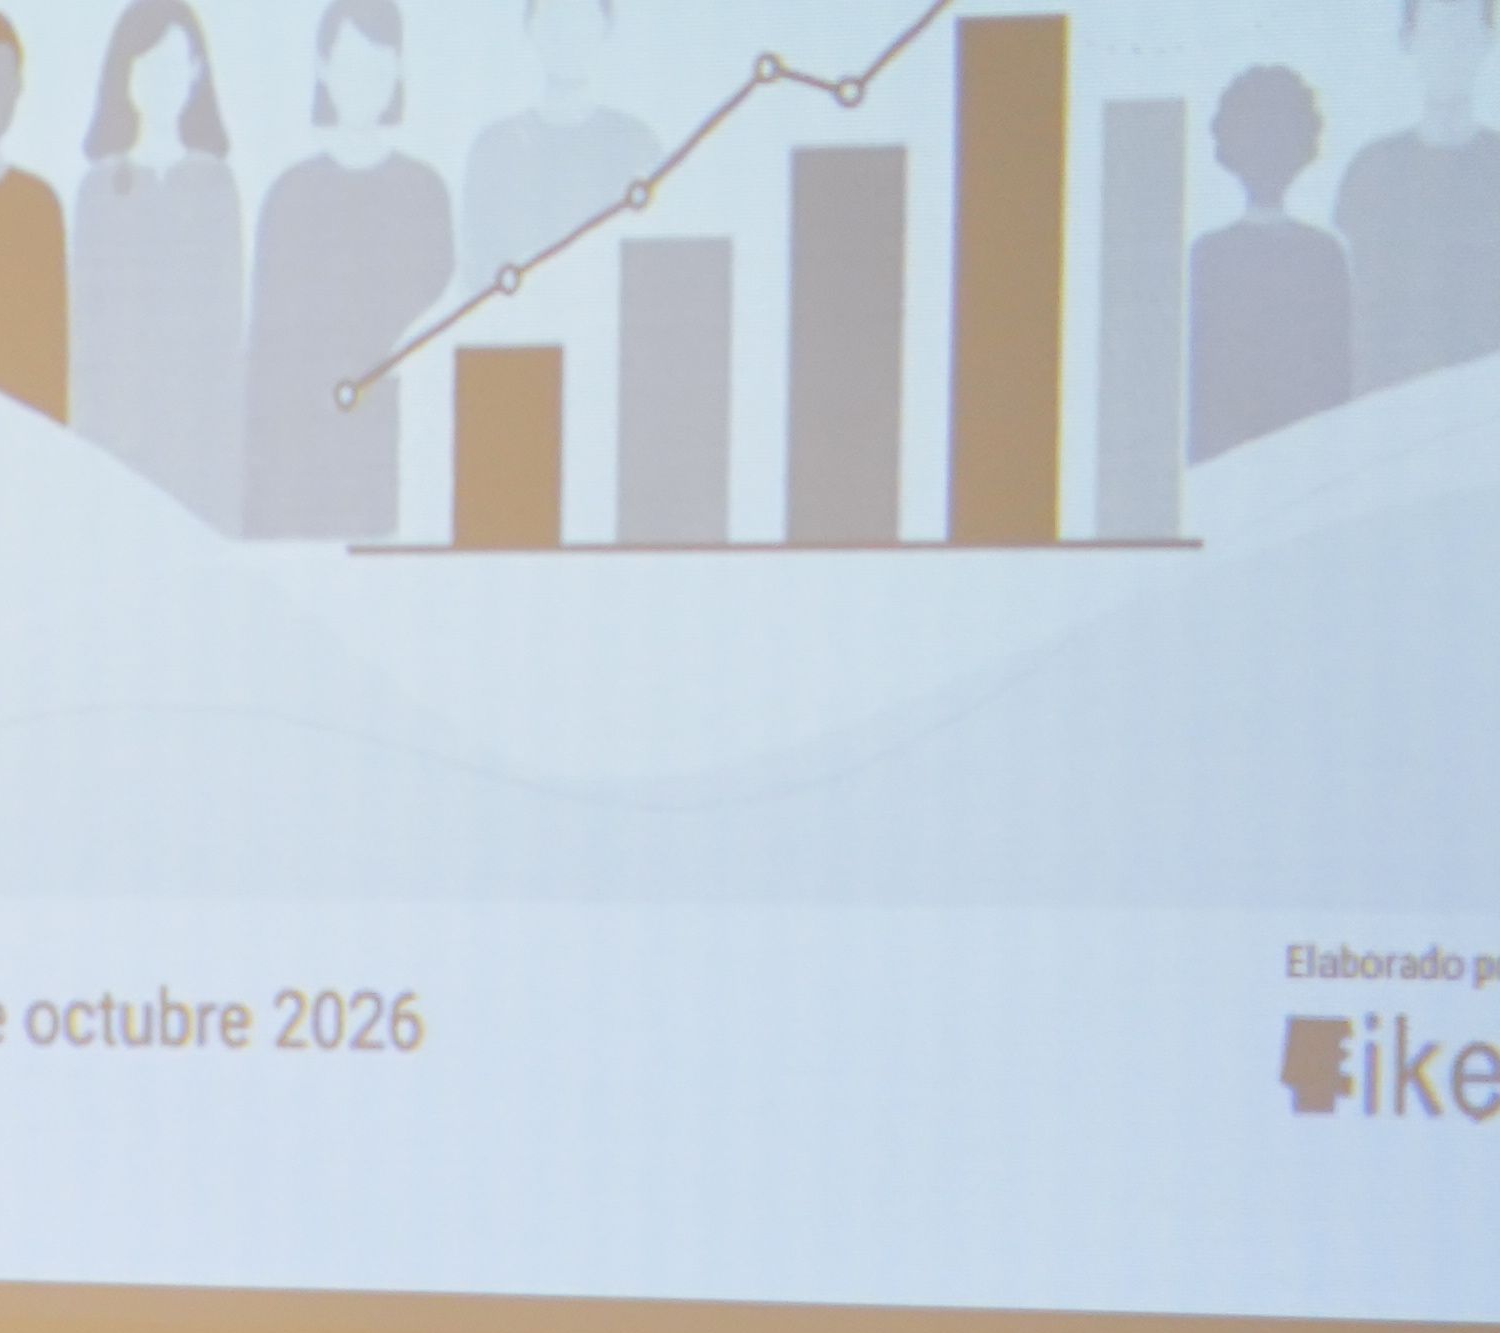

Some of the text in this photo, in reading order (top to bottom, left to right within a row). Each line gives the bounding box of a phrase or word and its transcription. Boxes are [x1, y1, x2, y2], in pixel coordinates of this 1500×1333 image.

[1286, 943, 1500, 990] Elaborado p
[25, 984, 252, 1049] octubre
[273, 989, 425, 1052] 2026
